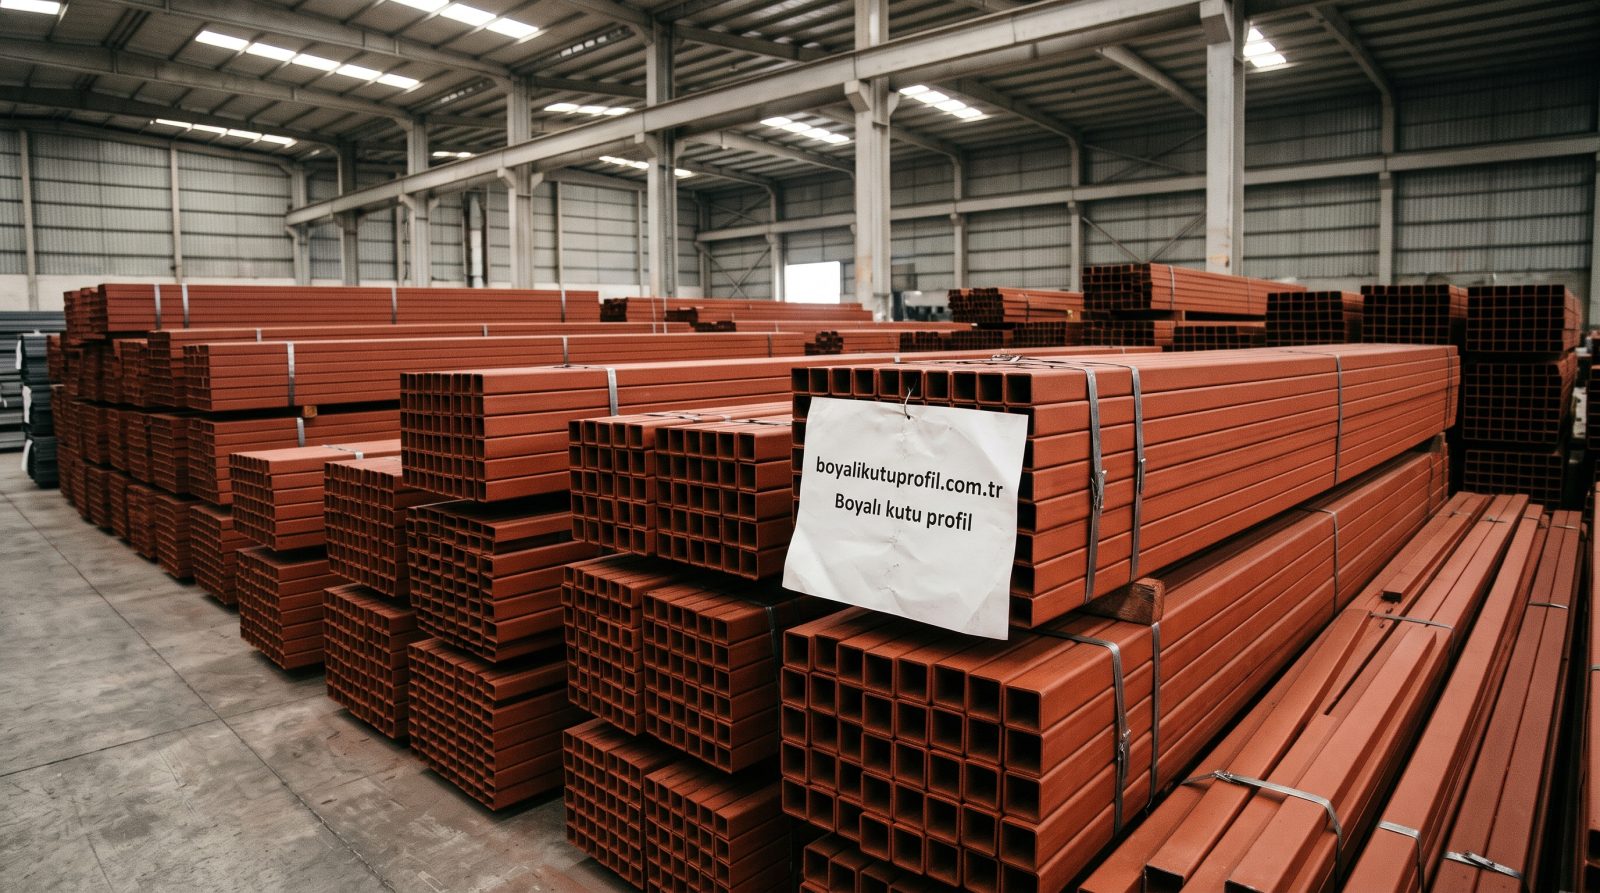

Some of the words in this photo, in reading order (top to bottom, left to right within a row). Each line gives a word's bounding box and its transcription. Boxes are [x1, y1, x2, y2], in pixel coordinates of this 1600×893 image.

[816, 456, 1003, 498] boyalikutuprofil.com.tr
[835, 493, 881, 516] Boyalı
[886, 500, 922, 523] kutu
[926, 512, 972, 532] profil
